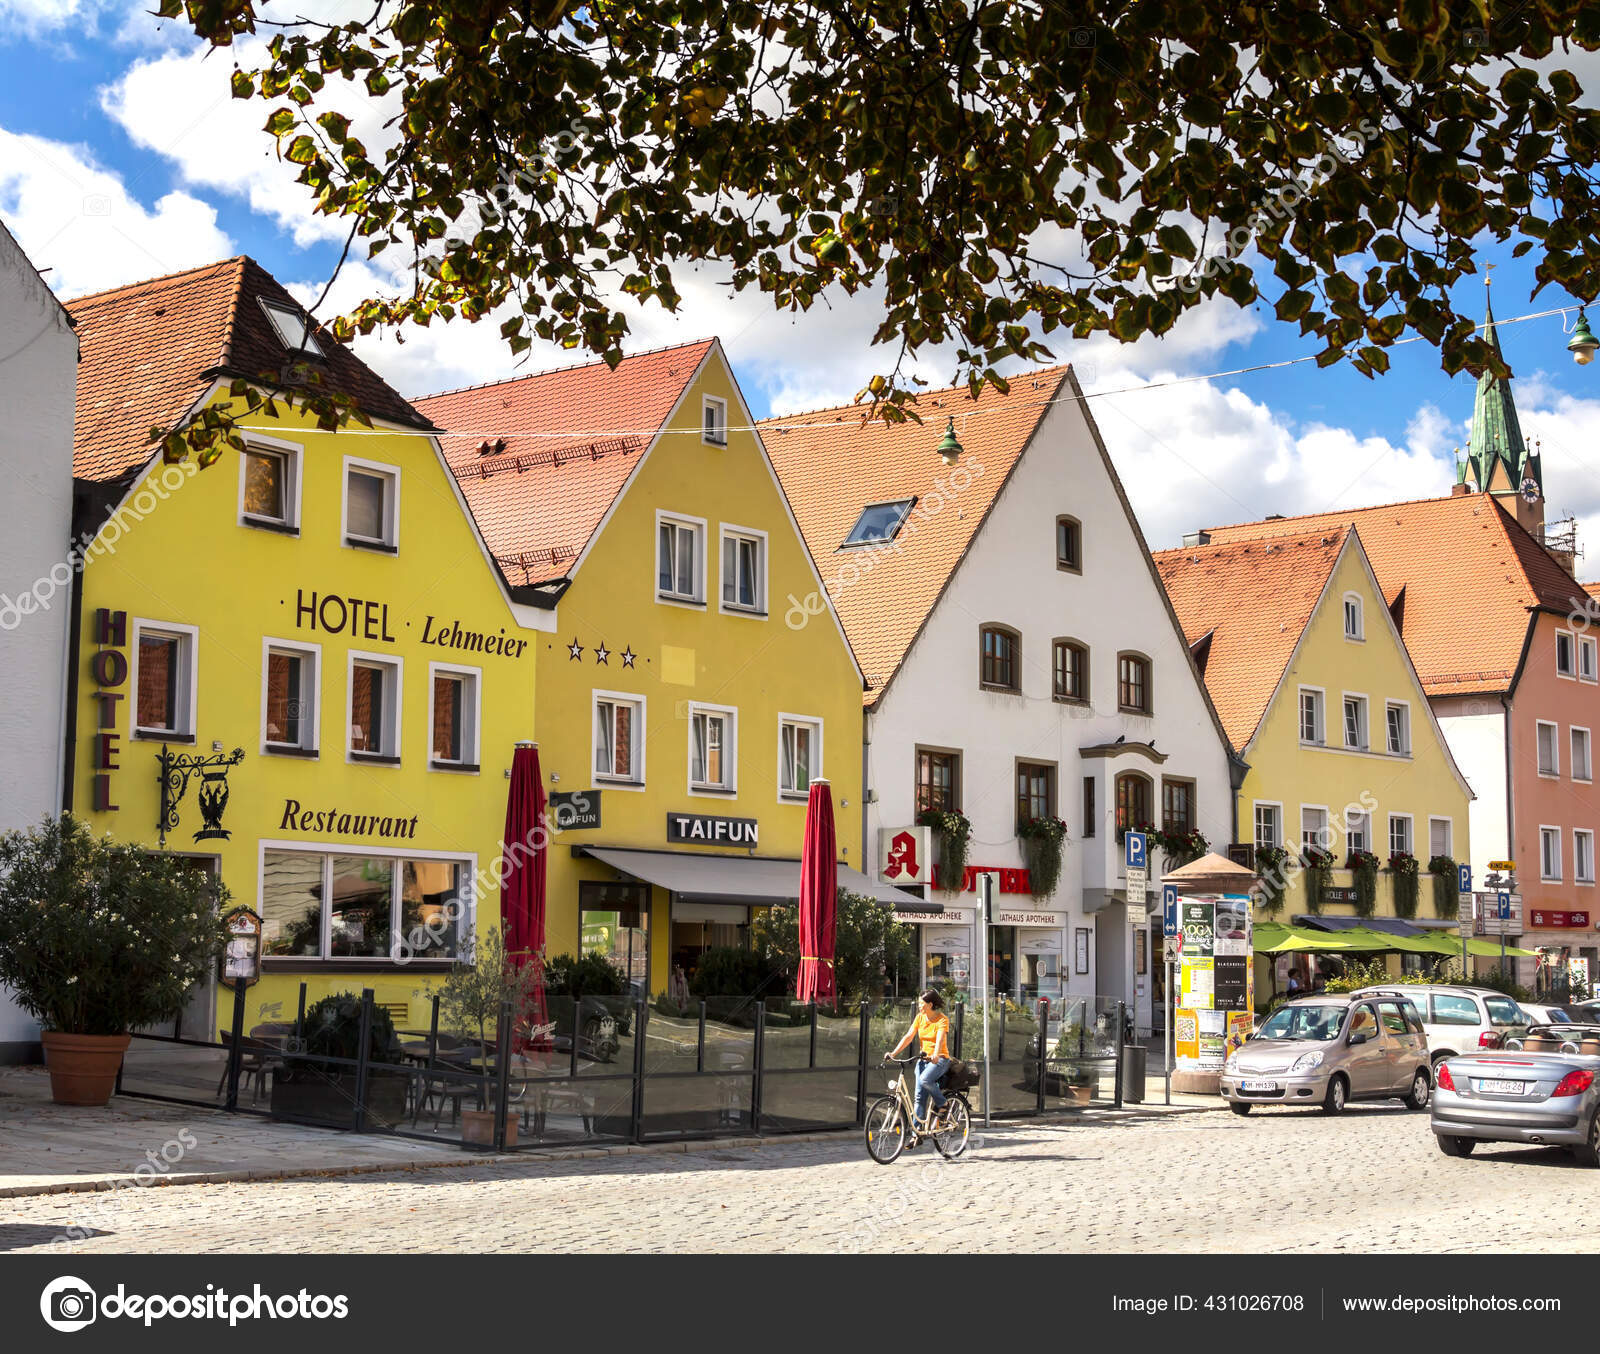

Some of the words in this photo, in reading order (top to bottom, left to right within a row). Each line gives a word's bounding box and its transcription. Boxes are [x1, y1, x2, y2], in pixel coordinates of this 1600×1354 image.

[297, 589, 395, 642] HOTEL
[421, 615, 527, 658] Lehmeier
[92, 608, 128, 811] HOTEL
[279, 799, 418, 838] Restaurant
[560, 814, 596, 825] TAIFUN
[677, 818, 758, 842] TAIFUN
[1130, 836, 1142, 862] P
[1461, 868, 1469, 889] P
[897, 911, 927, 919] RATHAUS
[929, 911, 962, 921] APOTHEKE
[1166, 890, 1175, 919] P
[1500, 896, 1508, 916] P
[1026, 914, 1056, 923] APOTHEKE
